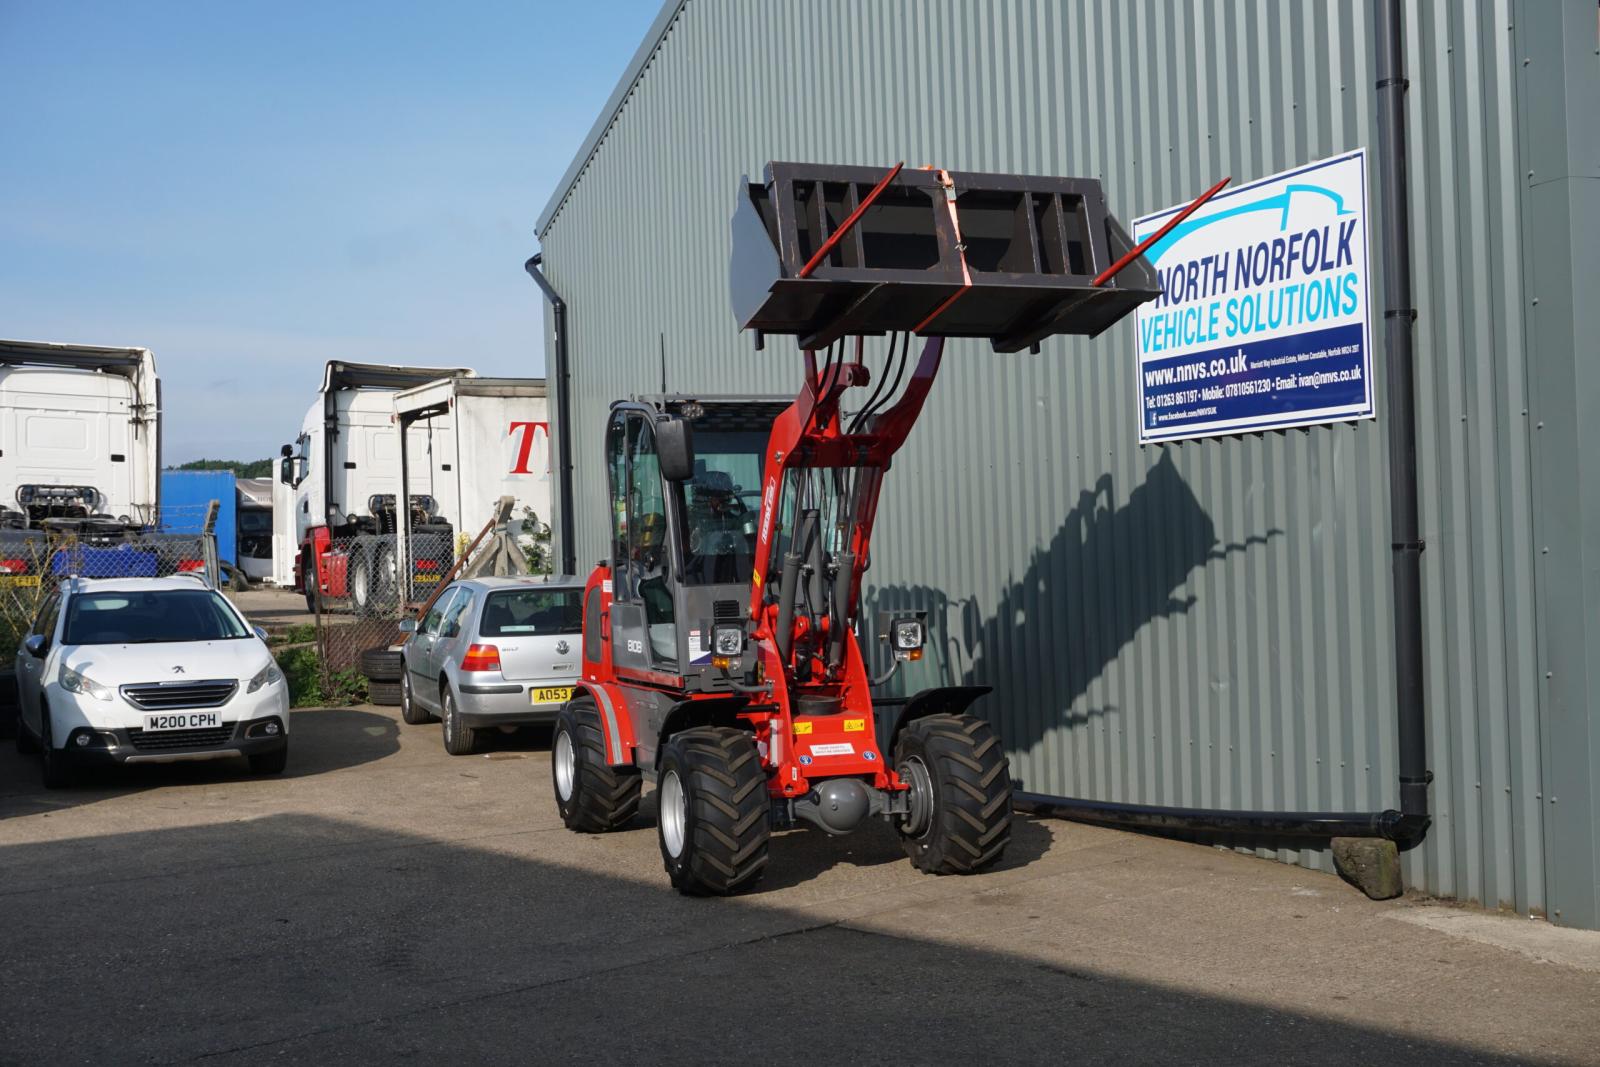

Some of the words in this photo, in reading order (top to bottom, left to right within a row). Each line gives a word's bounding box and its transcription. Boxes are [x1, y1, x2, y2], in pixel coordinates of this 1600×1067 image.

[1156, 252, 1230, 308] NORTH
[1235, 219, 1357, 291] NORFOLK
[1142, 301, 1221, 353] VEHICLE
[1226, 272, 1358, 338] SOLUTIONS
[1146, 349, 1248, 387] www.nnvs.co.uk
[1146, 396, 1156, 409] Tel:
[1156, 394, 1175, 407] 01263
[1176, 390, 1198, 405] 861197
[1202, 385, 1225, 401] Mobile:
[1225, 379, 1271, 398] 07810561230
[1276, 373, 1297, 390] Email:
[1298, 365, 1361, 388] ivan@nnvs.co.uk
[509, 422, 552, 474] T
[150, 716, 186, 729] M200
[190, 714, 216, 726] CPH
